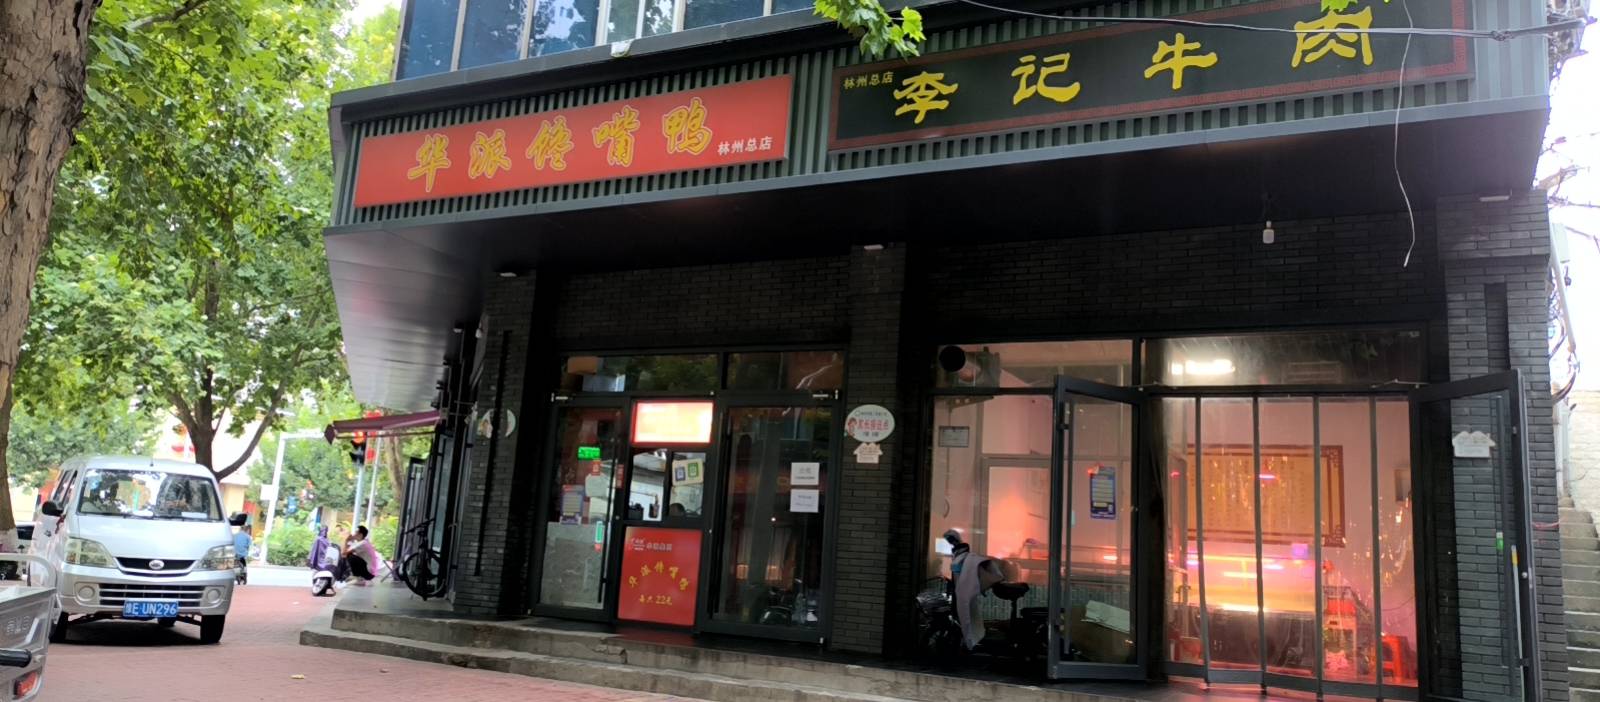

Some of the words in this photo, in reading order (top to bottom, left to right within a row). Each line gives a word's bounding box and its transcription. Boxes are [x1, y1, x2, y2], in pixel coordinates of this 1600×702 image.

[843, 71, 894, 89] 林州总店
[893, 6, 1373, 124] 李记牛肉
[407, 97, 712, 192] 华派馋嘴鸭
[717, 135, 773, 155] 林州总店
